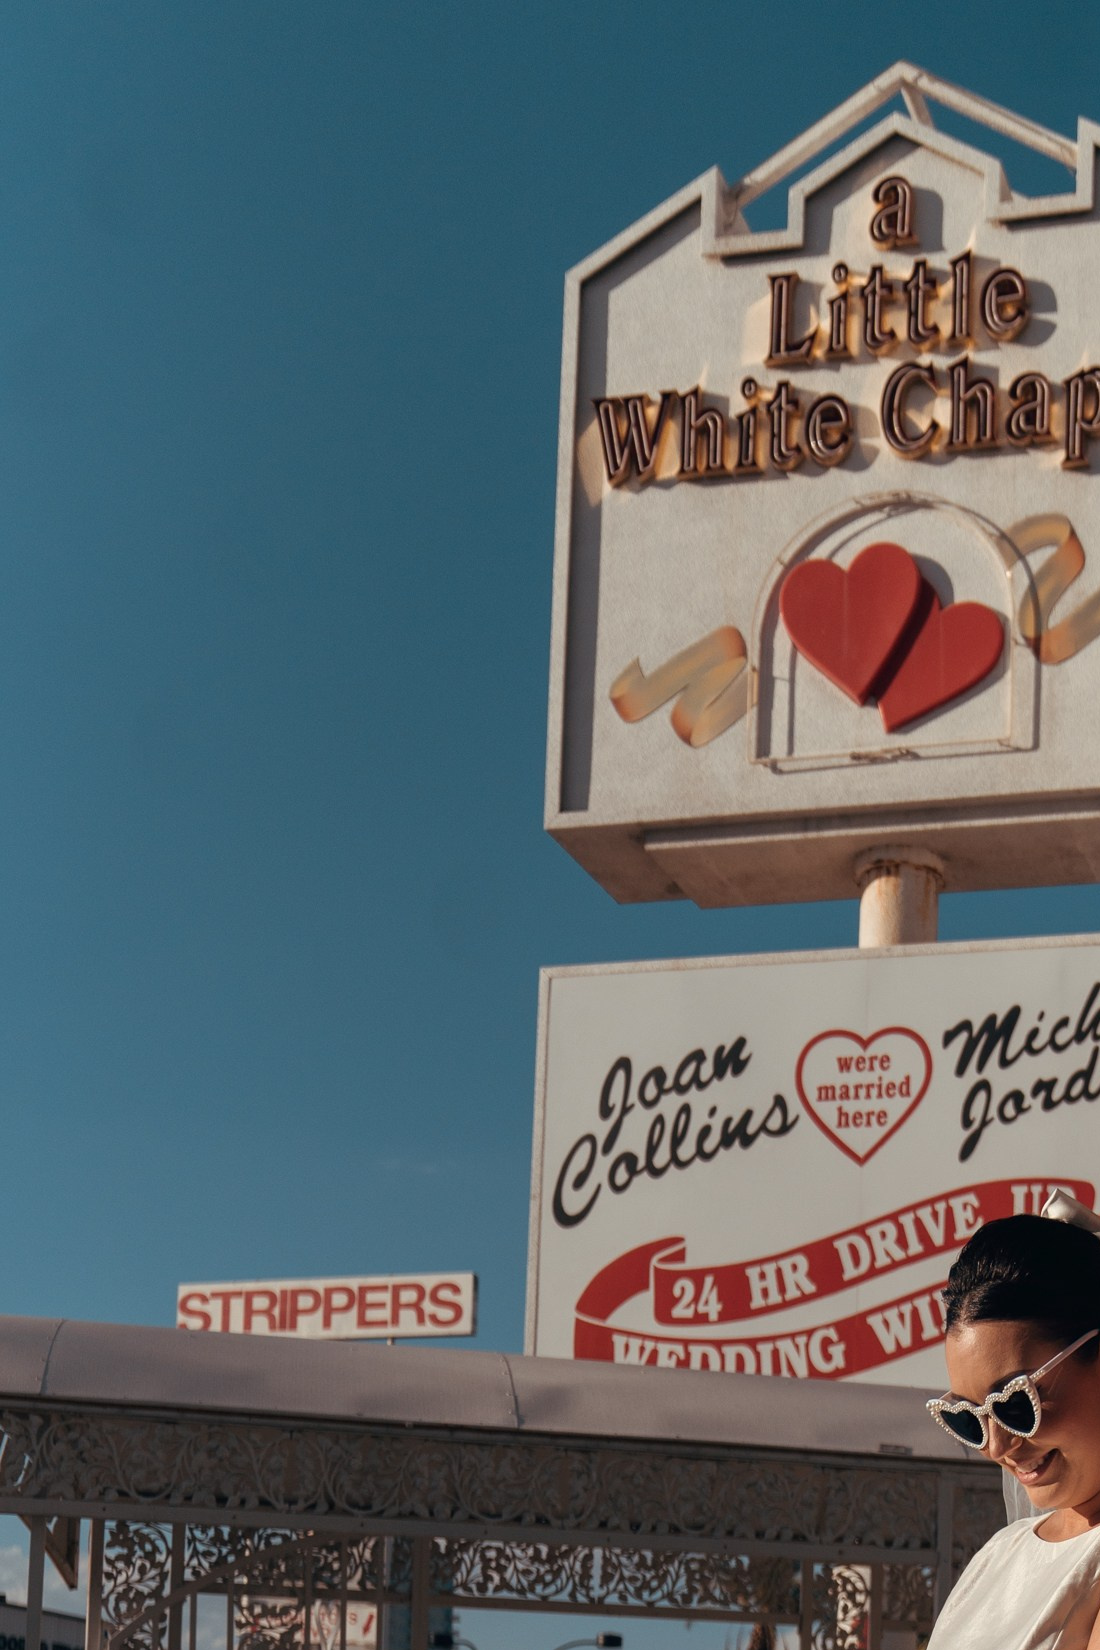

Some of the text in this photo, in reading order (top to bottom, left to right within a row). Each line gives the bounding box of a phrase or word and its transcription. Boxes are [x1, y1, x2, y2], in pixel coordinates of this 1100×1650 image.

[868, 174, 917, 250] a
[764, 250, 1028, 368] Little
[593, 376, 852, 487] White
[599, 1035, 752, 1156] Joan
[815, 1074, 912, 1102] married
[836, 1052, 891, 1073] were
[836, 1106, 888, 1129] here
[552, 1093, 800, 1228] Collins
[670, 1274, 723, 1322] 24
[745, 1253, 816, 1310] HR
[833, 1192, 984, 1281] DRIVE
[178, 1282, 464, 1333] STRIPPERS
[866, 1289, 947, 1355] WI
